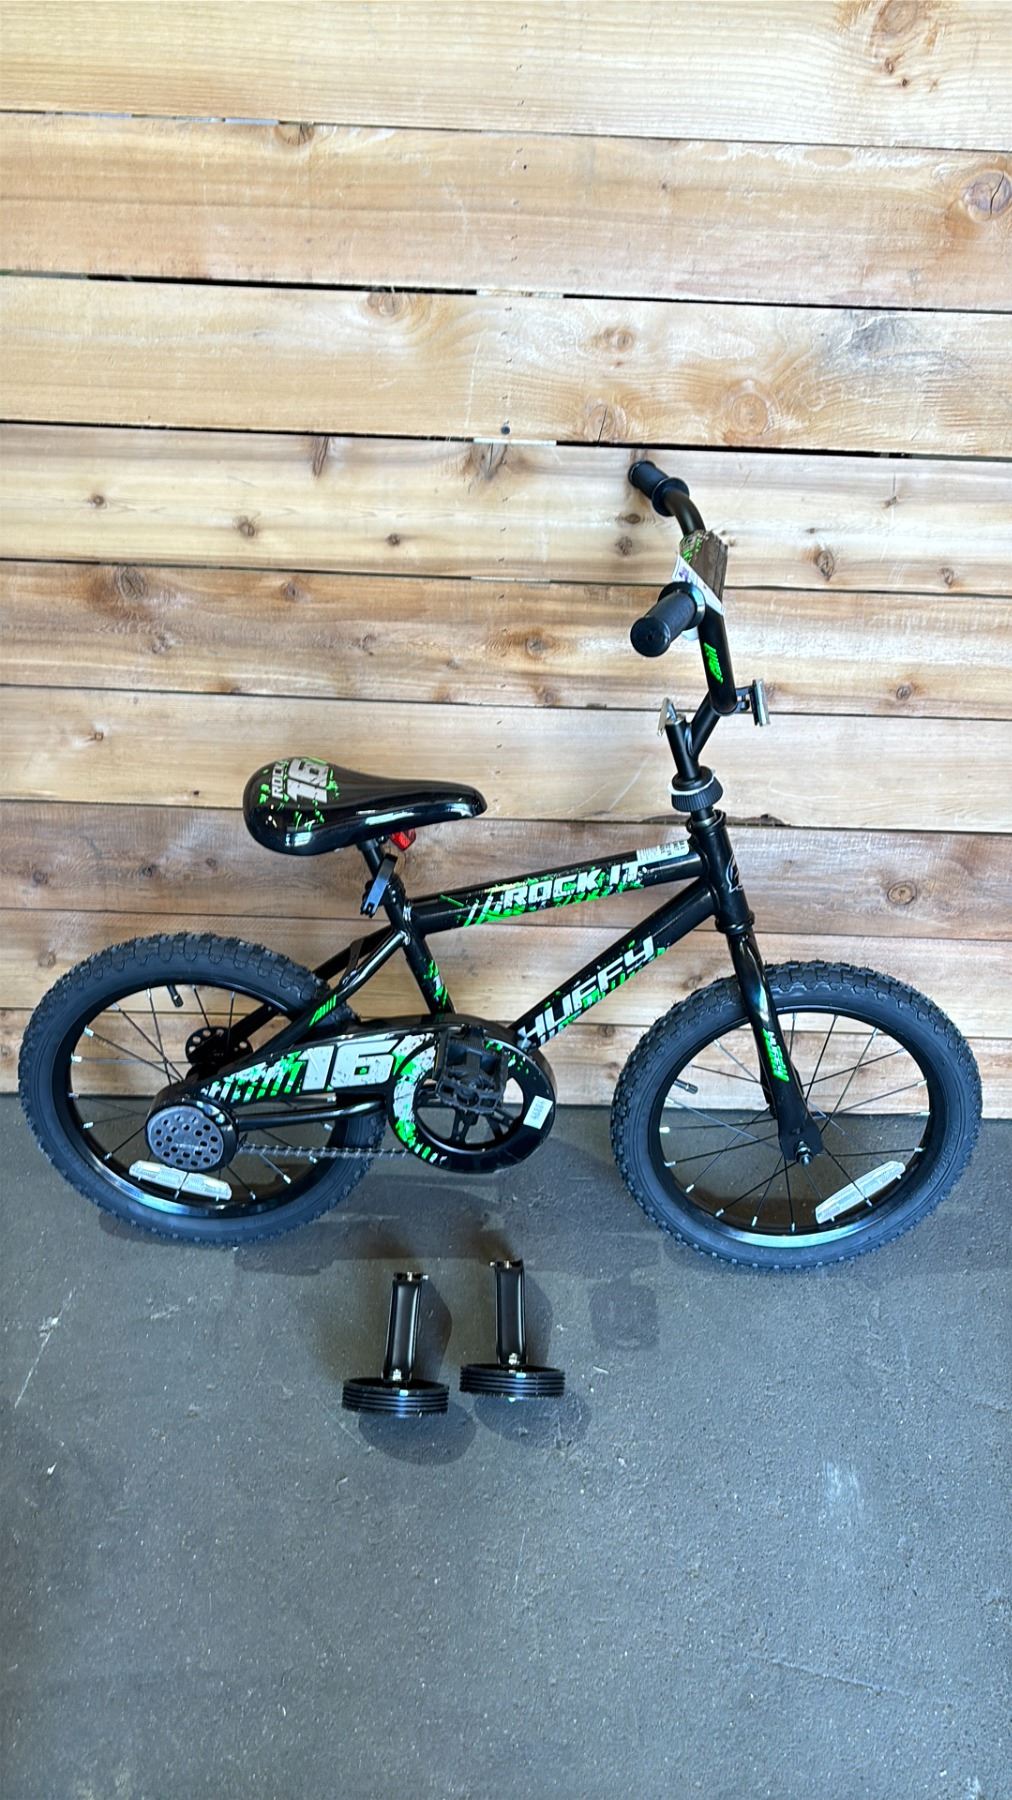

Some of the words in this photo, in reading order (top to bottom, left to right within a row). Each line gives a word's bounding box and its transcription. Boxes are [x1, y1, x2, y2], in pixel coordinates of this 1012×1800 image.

[287, 758, 328, 803] 16
[503, 868, 602, 908] ROCK
[609, 860, 639, 886] IT
[518, 936, 654, 1042] HUFFY
[298, 1039, 399, 1091] 16
